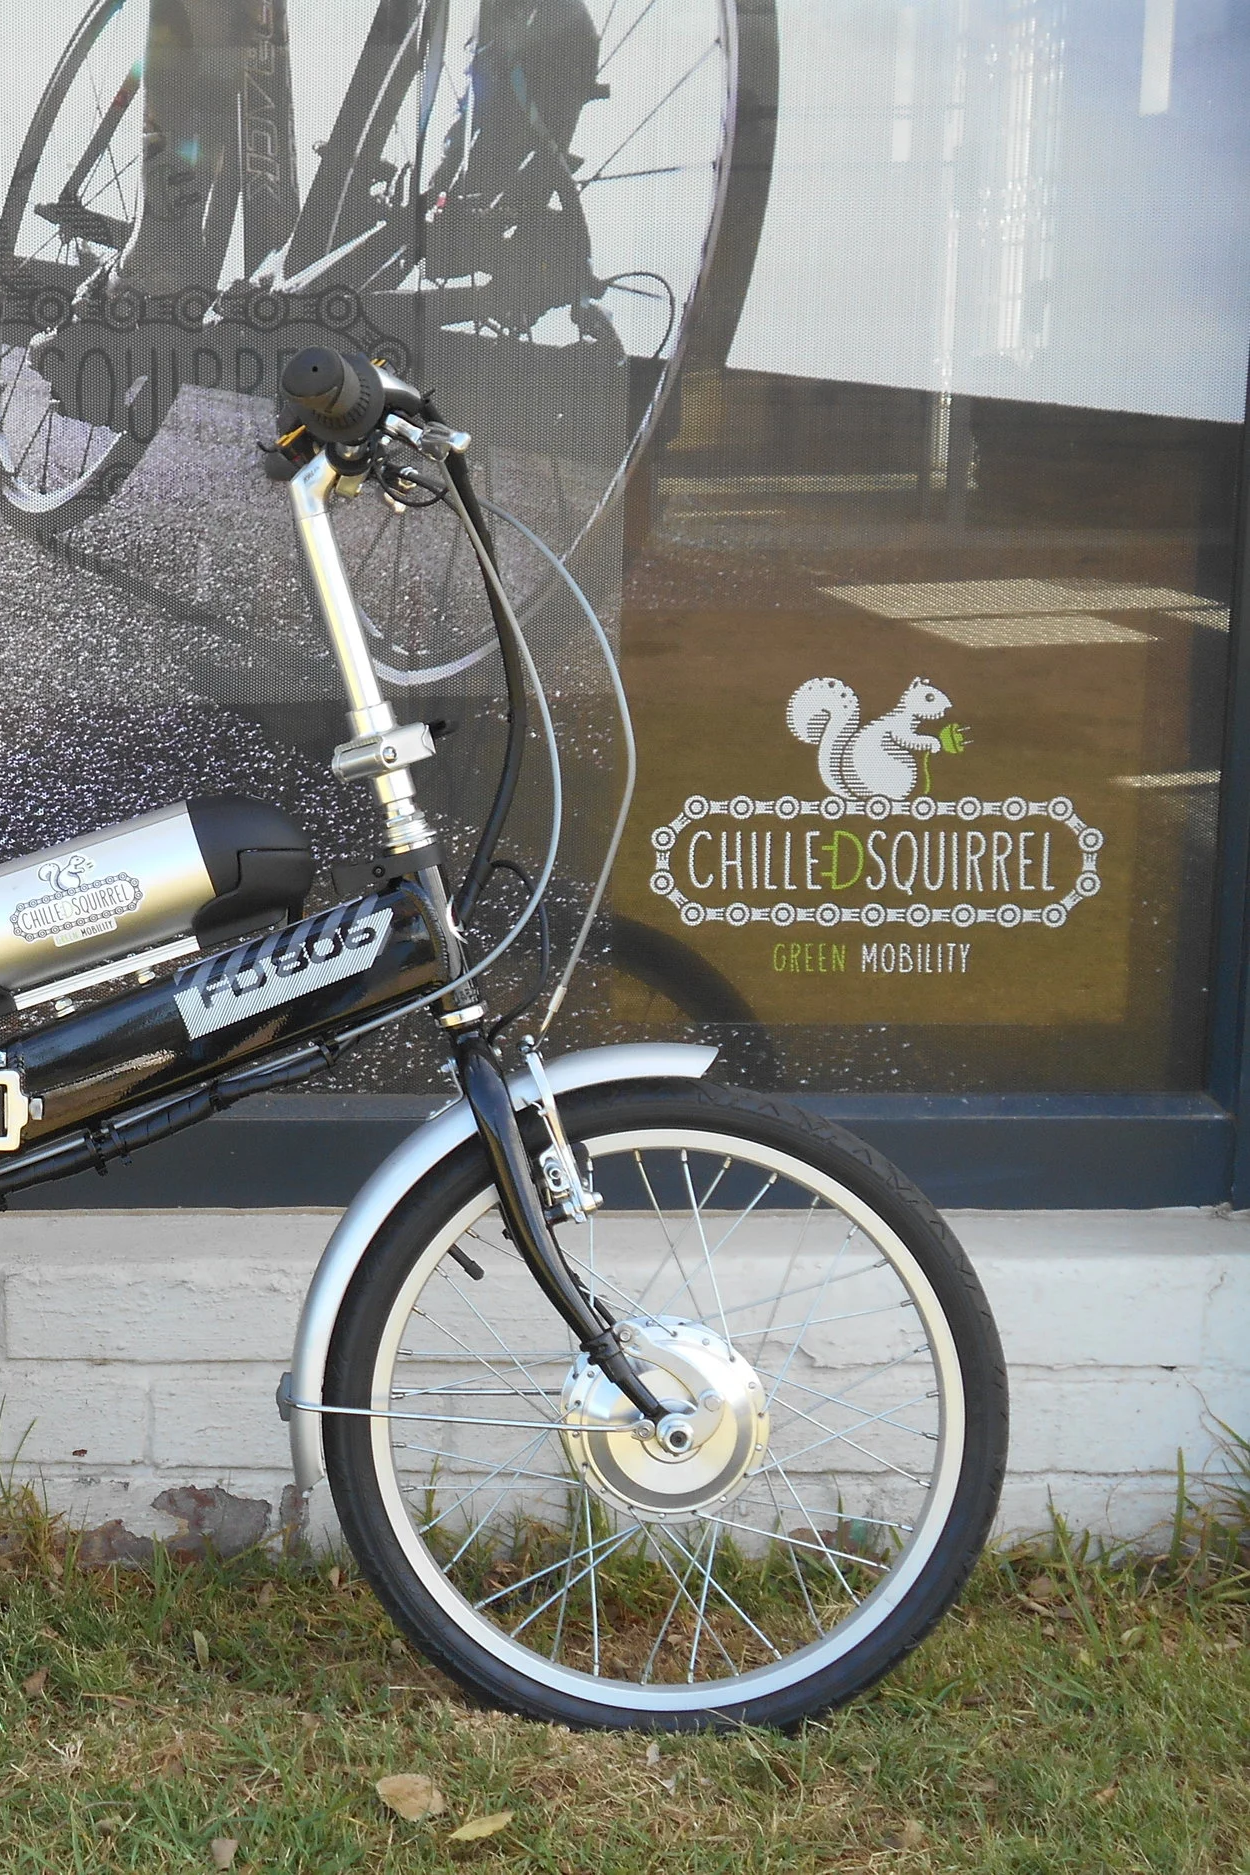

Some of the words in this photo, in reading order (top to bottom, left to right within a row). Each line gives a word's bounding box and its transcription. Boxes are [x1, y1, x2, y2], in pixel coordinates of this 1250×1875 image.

[81, 920, 114, 938] MOBILITY
[773, 943, 846, 973] GREEN
[861, 943, 971, 973] MOBILITY
